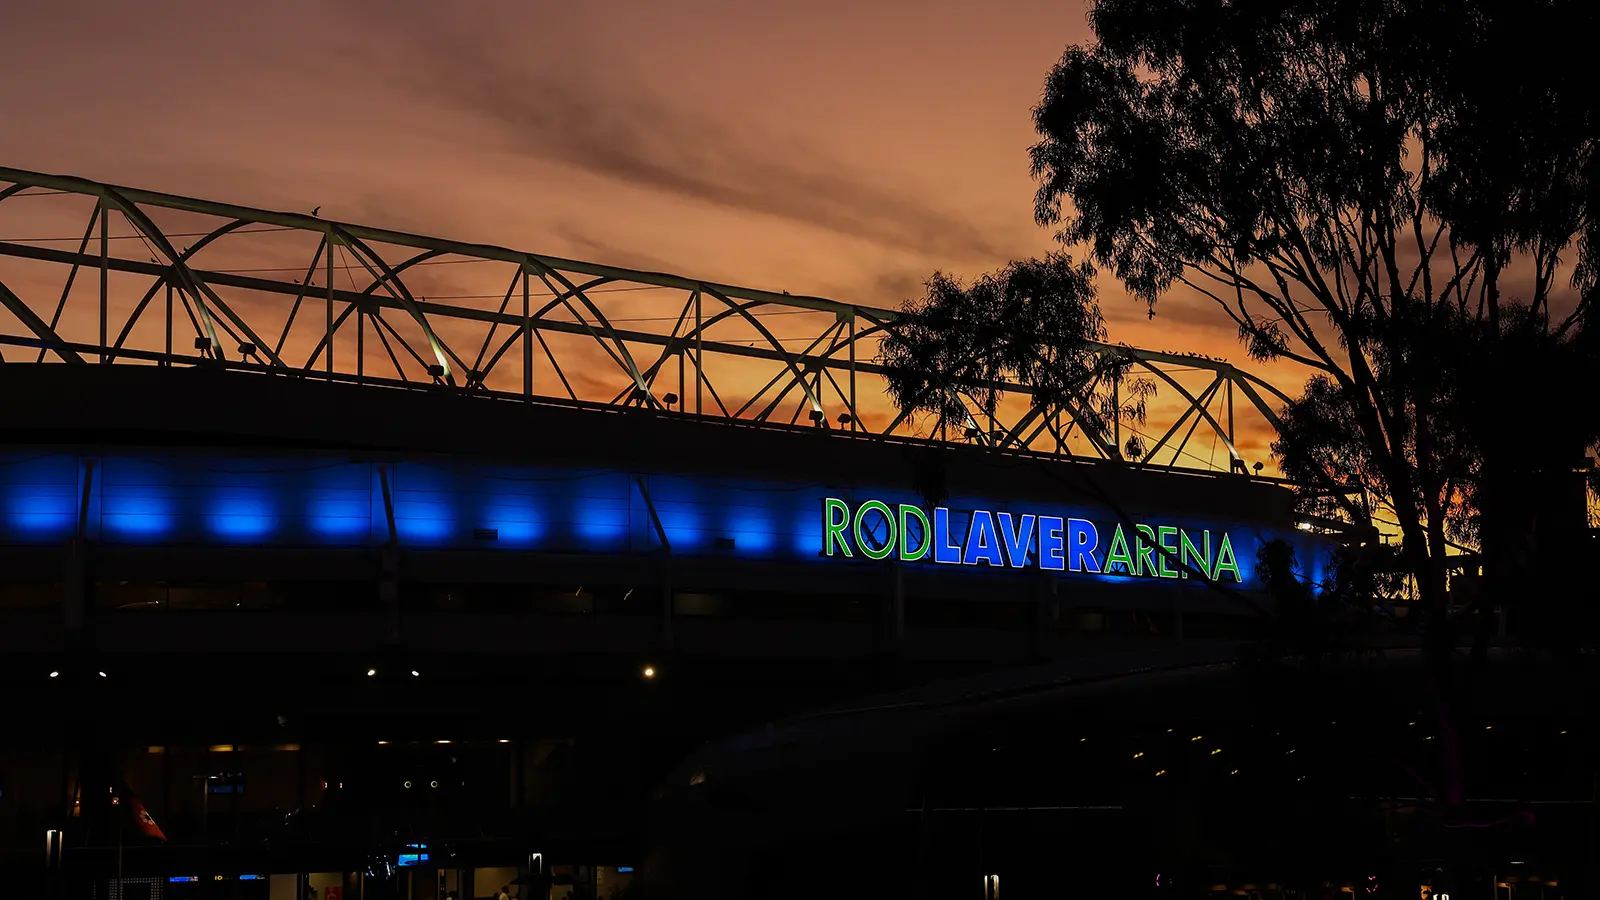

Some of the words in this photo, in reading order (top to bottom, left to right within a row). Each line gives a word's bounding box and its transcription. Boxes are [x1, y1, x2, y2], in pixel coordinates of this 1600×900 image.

[826, 498, 931, 560] ROD
[934, 507, 1101, 573] LAVER
[1104, 523, 1242, 583] ARENA
